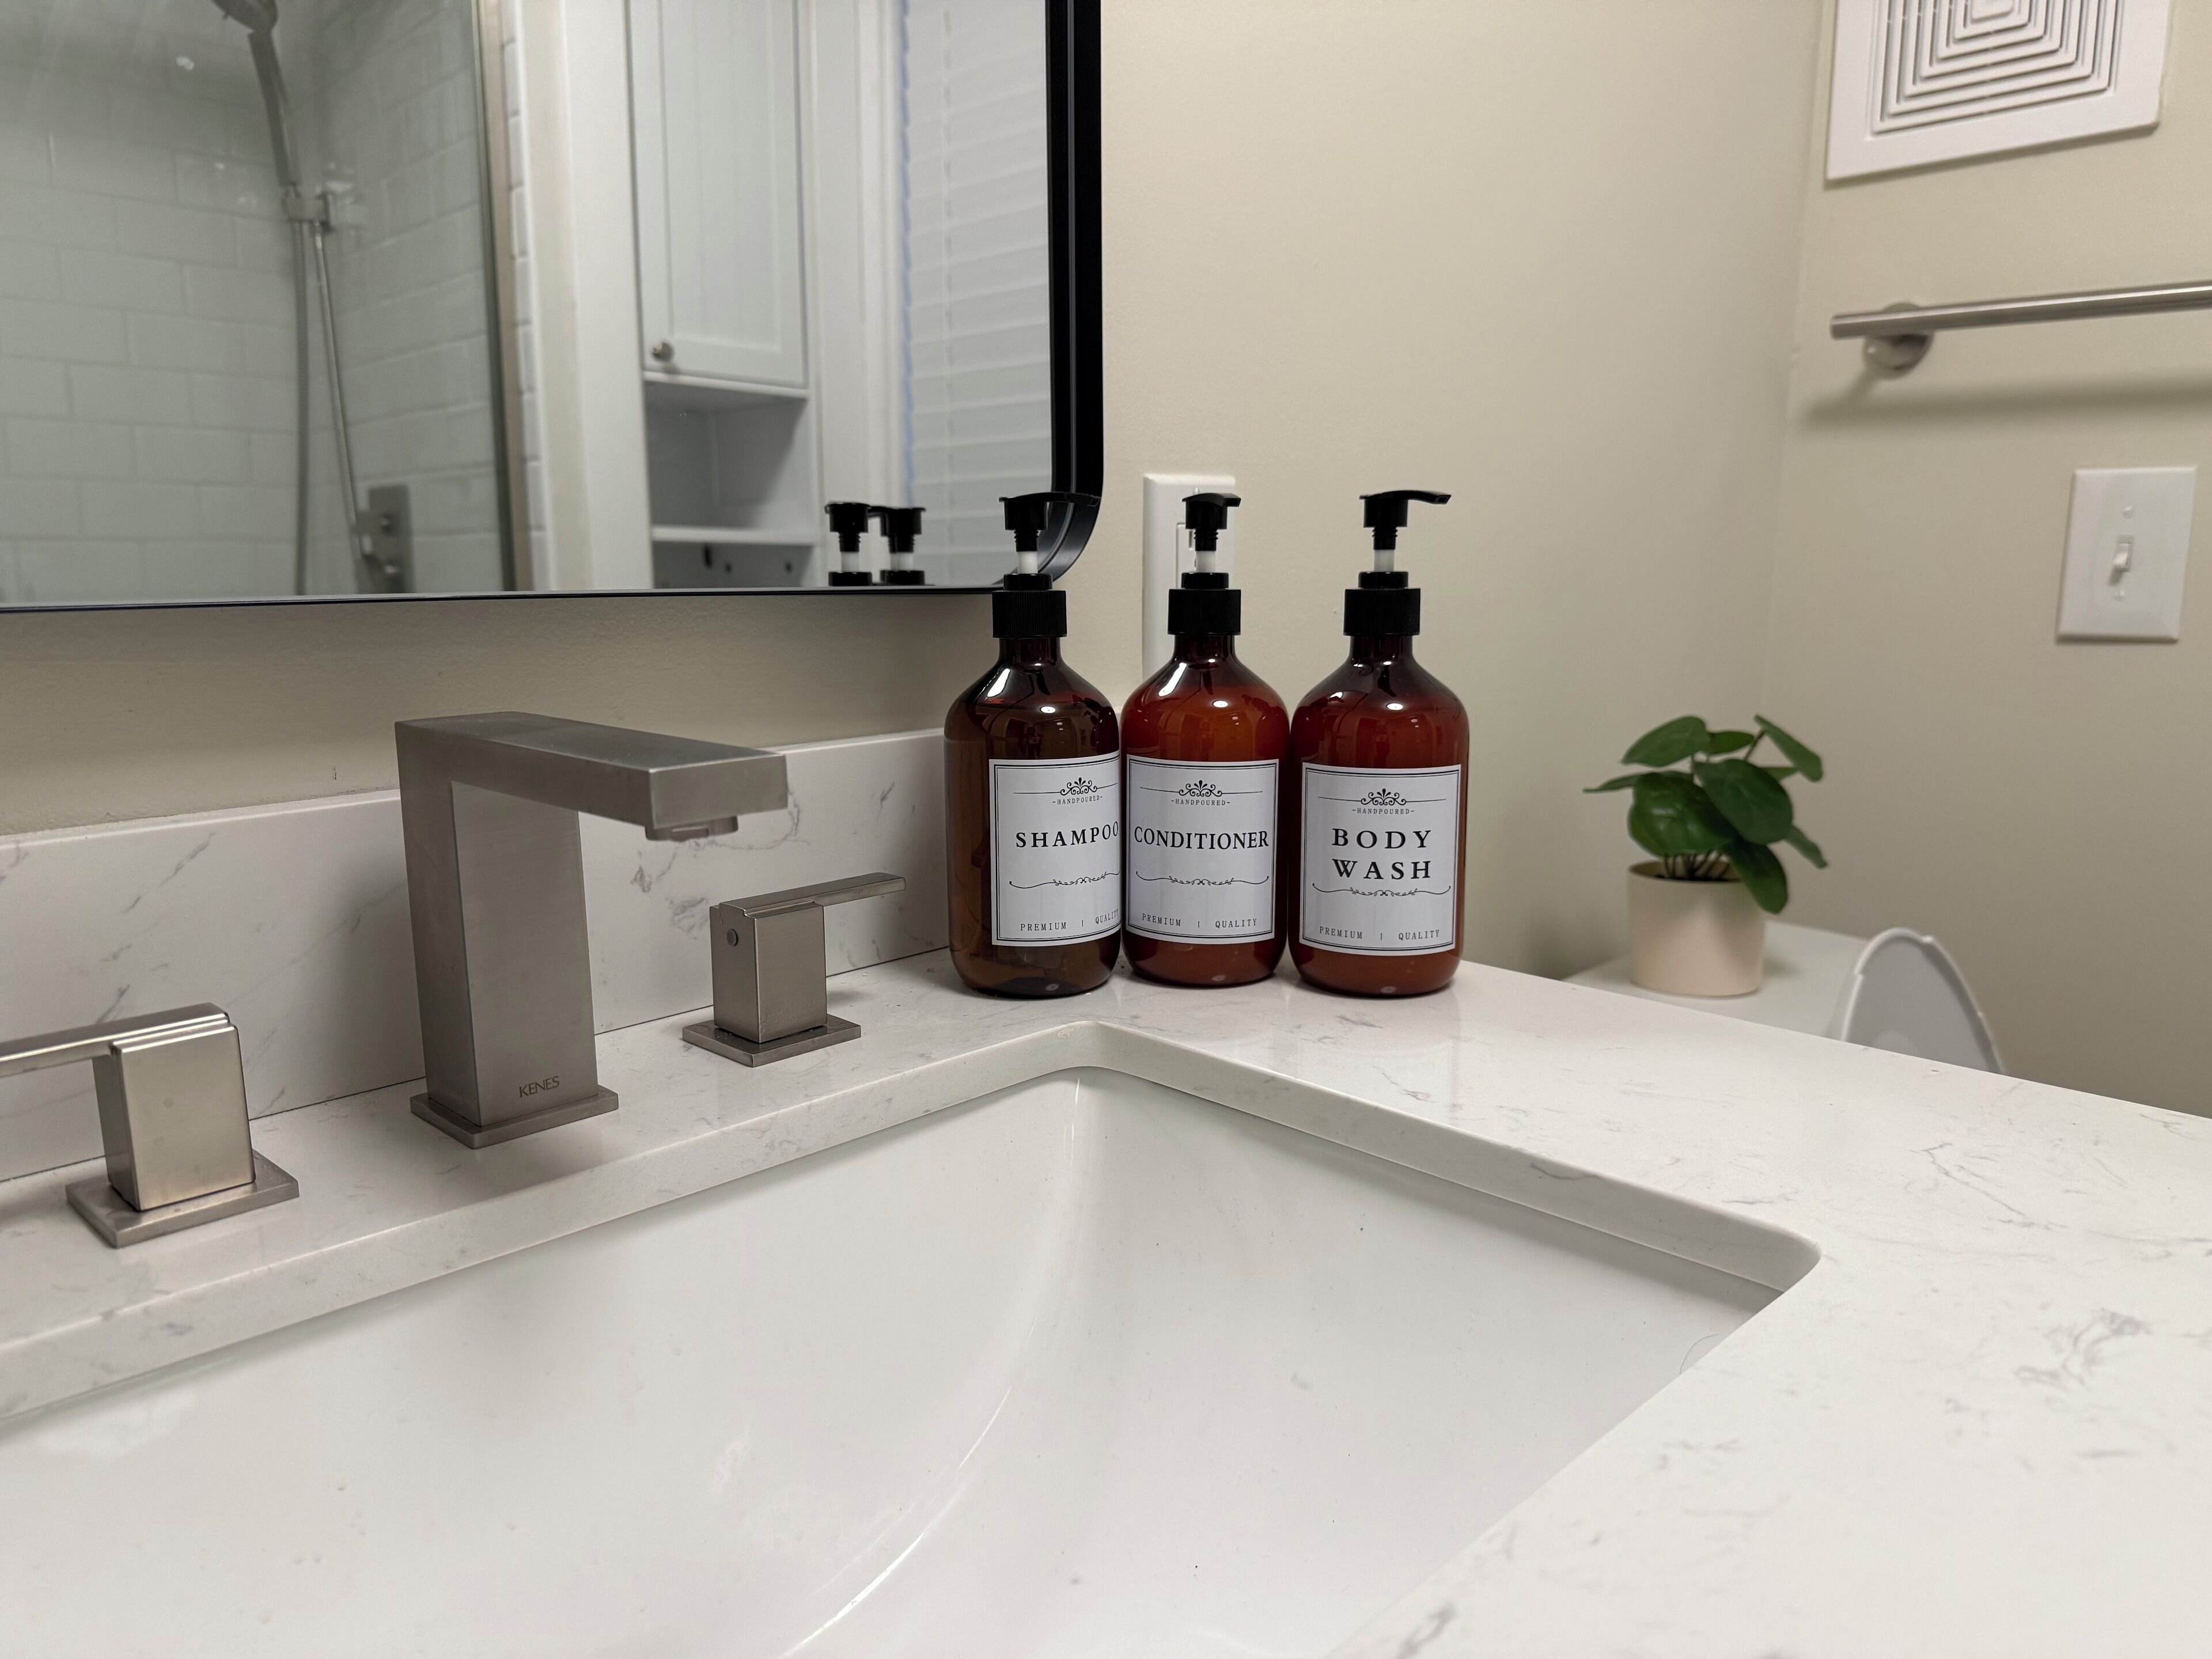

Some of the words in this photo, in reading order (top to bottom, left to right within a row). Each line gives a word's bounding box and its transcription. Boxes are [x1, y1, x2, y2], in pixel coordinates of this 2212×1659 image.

[1016, 821, 1119, 848] SHAMPOO
[1134, 826, 1269, 850] CONDITIONER
[1331, 828, 1431, 849] BODY
[1331, 858, 1431, 880] WASH
[1020, 922, 1067, 931] PREMIUM
[1142, 913, 1181, 926] PREMIUM
[1215, 918, 1257, 929] QUALITY
[1319, 926, 1363, 940] PREMIUM
[1398, 929, 1440, 941] QUALITY
[519, 1075, 560, 1098] KENES
